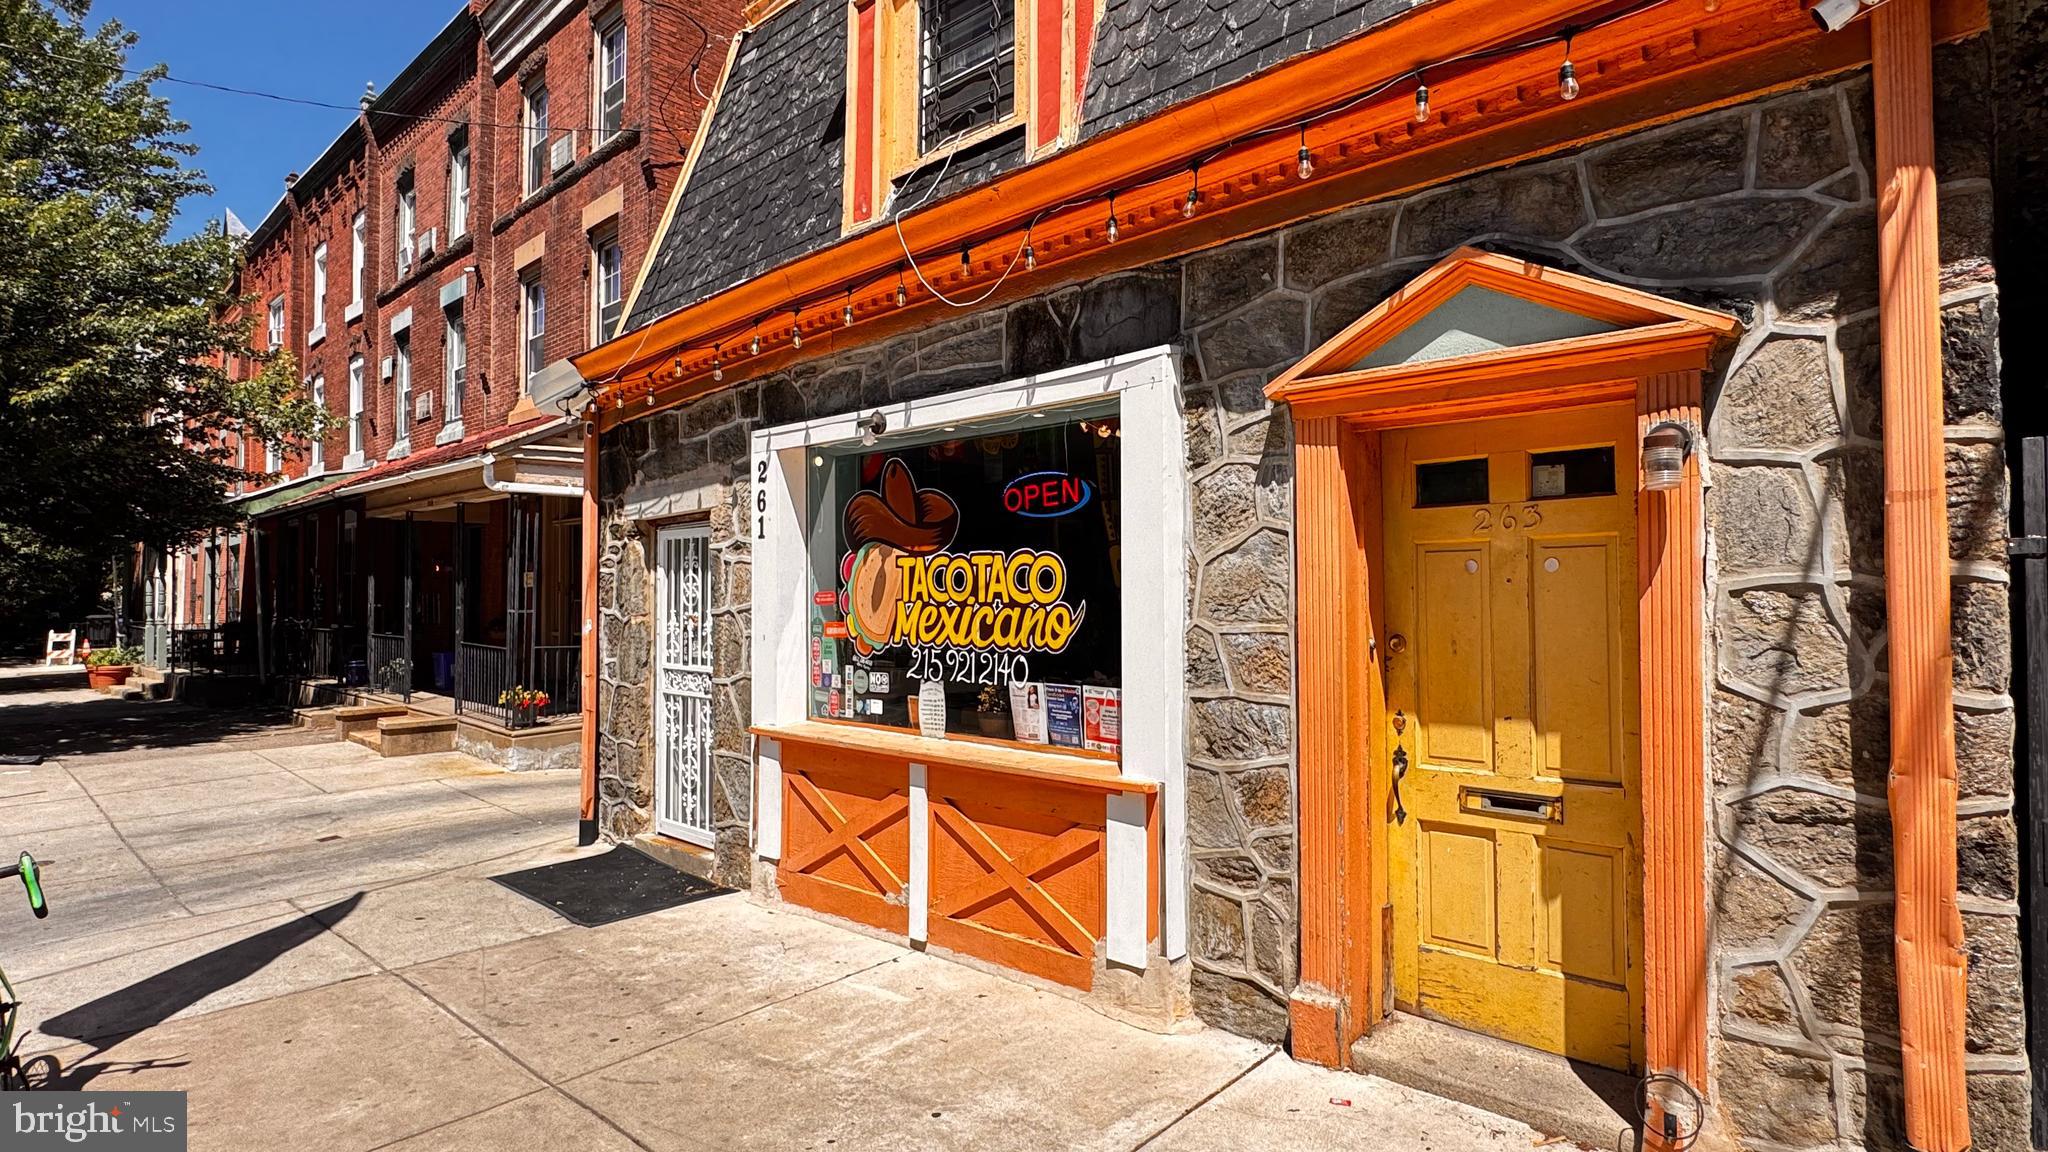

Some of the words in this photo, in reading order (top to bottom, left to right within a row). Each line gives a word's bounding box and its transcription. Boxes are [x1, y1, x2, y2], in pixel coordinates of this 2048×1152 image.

[757, 460, 768, 539] 261
[1003, 477, 1081, 513] OPEN
[1472, 504, 1543, 534] 263
[897, 555, 974, 603] TACO
[971, 553, 1063, 604] TACO
[893, 597, 1084, 650] Mexicano
[906, 648, 943, 682] 215
[946, 650, 976, 683] 921
[978, 652, 1029, 688] 2140
